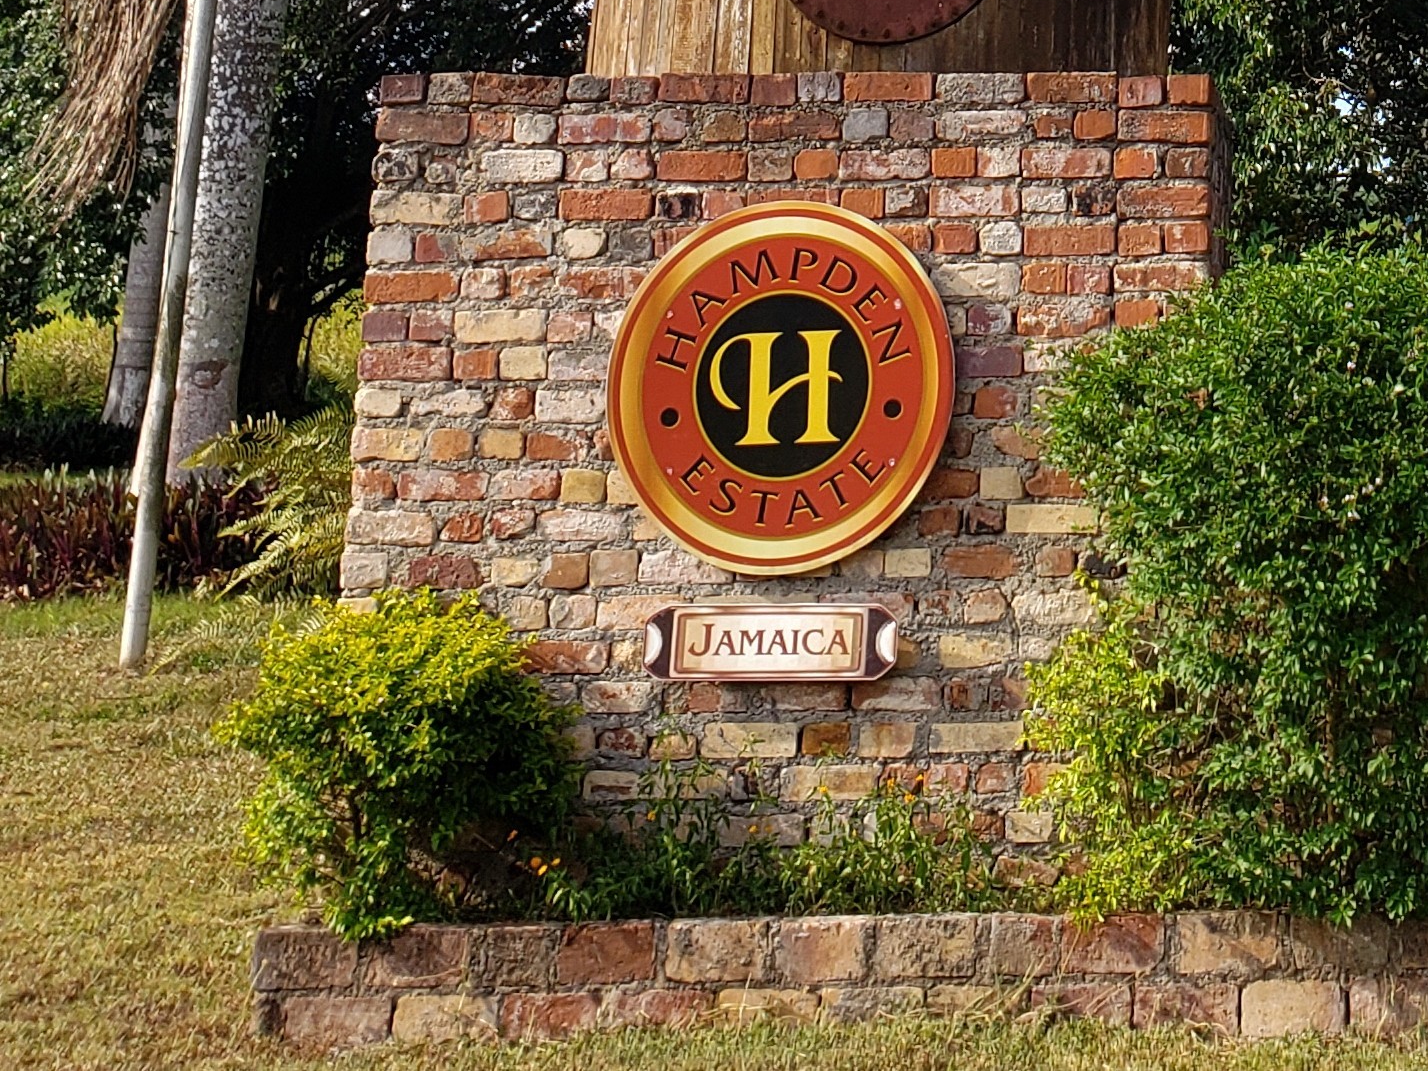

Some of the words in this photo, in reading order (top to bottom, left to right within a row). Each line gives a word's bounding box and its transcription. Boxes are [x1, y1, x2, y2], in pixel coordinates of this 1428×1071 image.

[655, 247, 912, 373] HAMPDEN
[709, 329, 843, 446] H
[679, 448, 886, 529] ESTATE
[687, 623, 850, 656] JAMAICA
